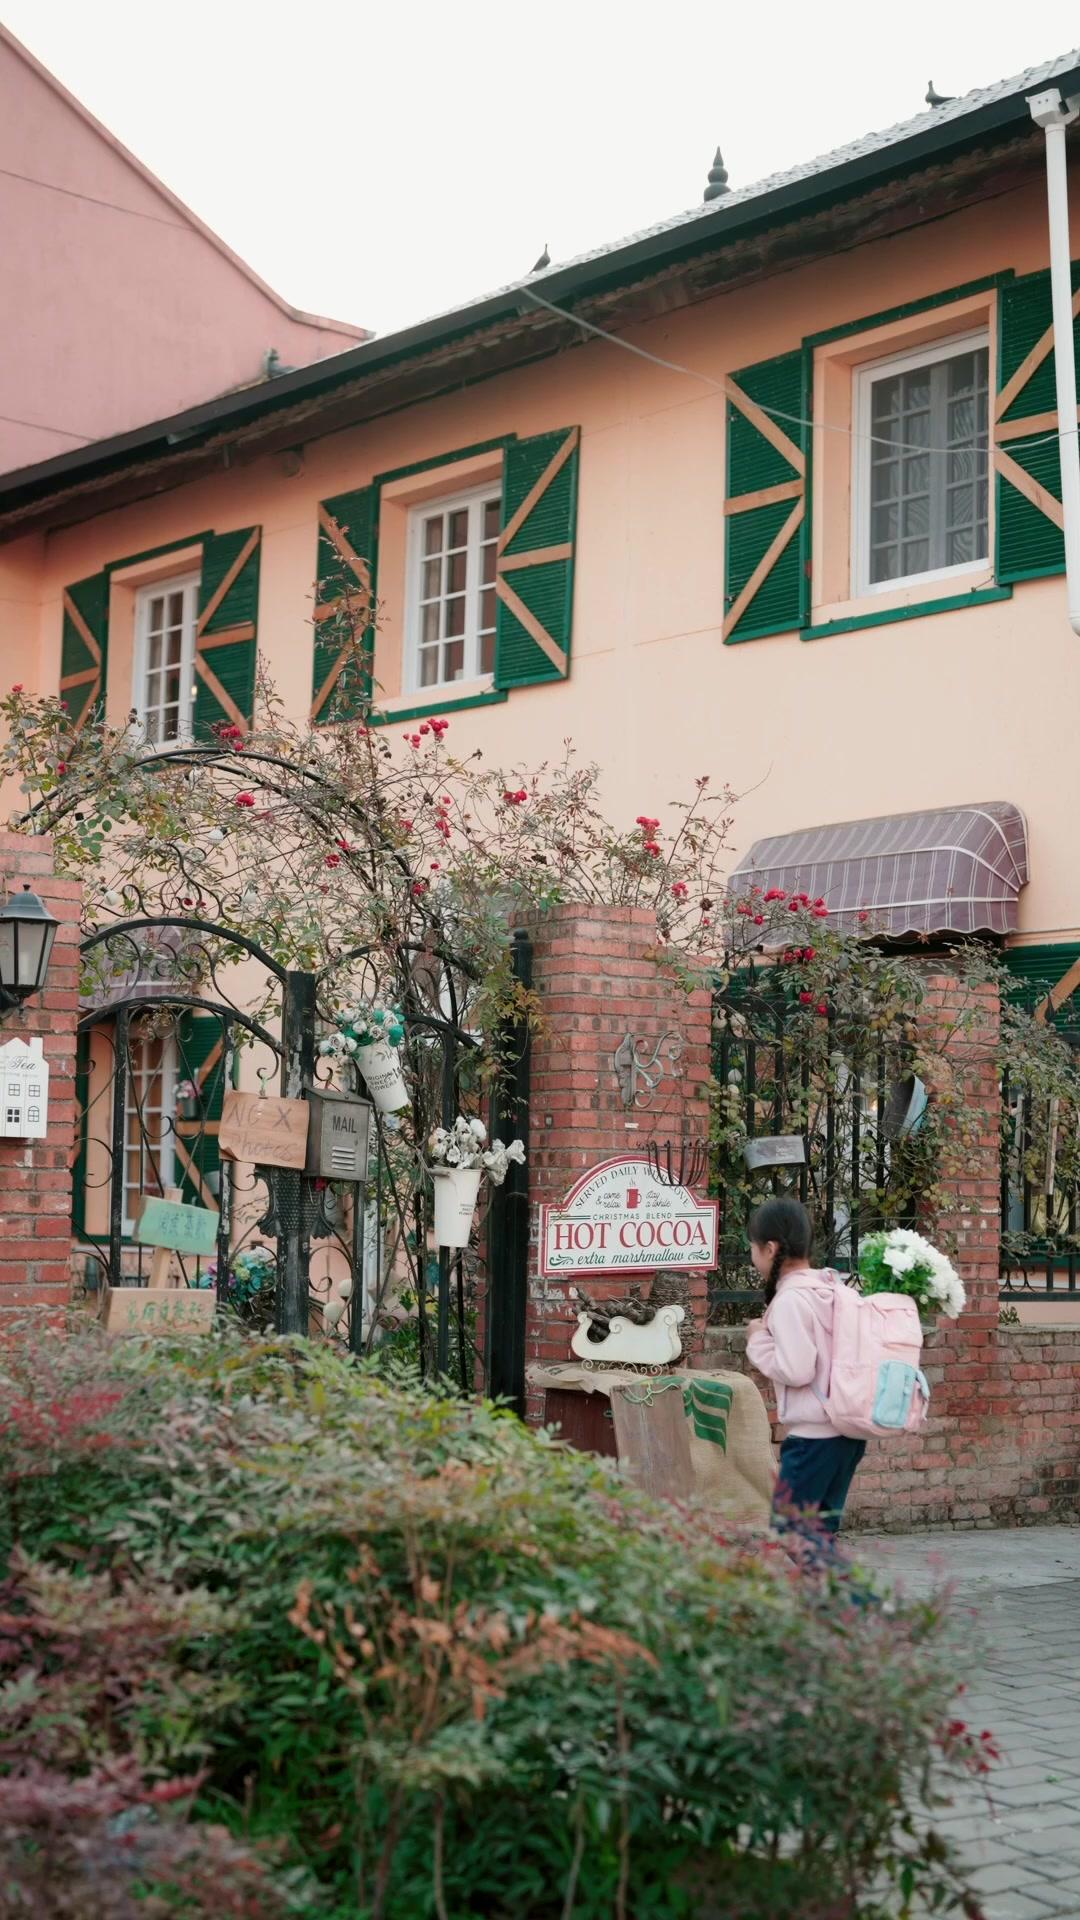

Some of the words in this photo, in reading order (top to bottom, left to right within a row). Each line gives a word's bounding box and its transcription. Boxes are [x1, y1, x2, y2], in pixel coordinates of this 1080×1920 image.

[10, 1056, 36, 1070] Tea
[332, 1115, 357, 1134] MAIL
[575, 1175, 608, 1209] SERVED
[610, 1165, 638, 1180] DAILY
[603, 1192, 621, 1200] come
[603, 1199, 621, 1208] relax
[592, 1213, 640, 1221] CHRISTMAS
[646, 1211, 672, 1220] BLEND
[553, 1222, 612, 1250] HOT
[619, 1220, 708, 1248] COCOA
[577, 1251, 606, 1265] extra
[611, 1248, 684, 1264] marshmallow
